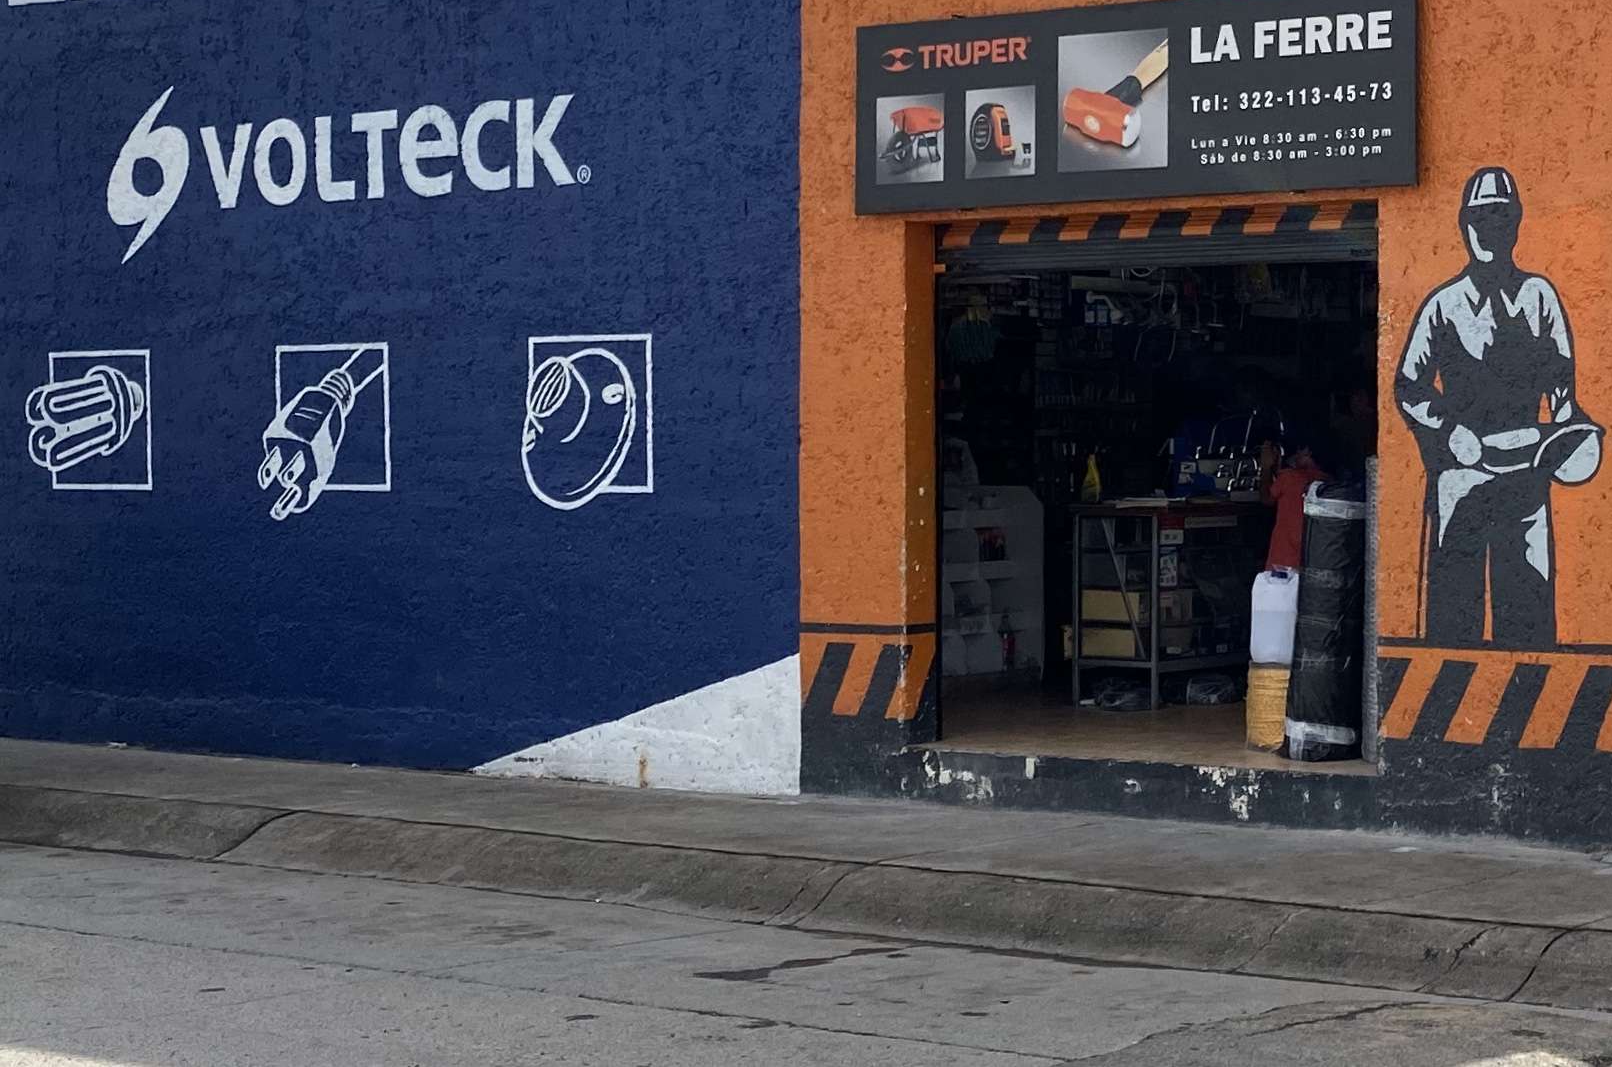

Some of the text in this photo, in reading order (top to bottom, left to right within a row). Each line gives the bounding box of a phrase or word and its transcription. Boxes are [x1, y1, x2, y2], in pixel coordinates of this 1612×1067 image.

[918, 36, 1028, 69] TRUPER
[1190, 10, 1393, 64] LA FERRE
[1191, 82, 1392, 113] Tel: 322-113-45-73
[1191, 138, 1216, 149] Lun
[1222, 139, 1229, 147] a
[1235, 135, 1256, 146] Vie
[1263, 132, 1292, 144] 8:30
[1298, 133, 1317, 142] am
[1335, 127, 1365, 139] 6:30
[1372, 127, 1392, 139] pm
[1231, 152, 1247, 163] de
[1289, 150, 1307, 159] am
[1326, 145, 1355, 157] 3:00
[1362, 145, 1382, 157] pm
